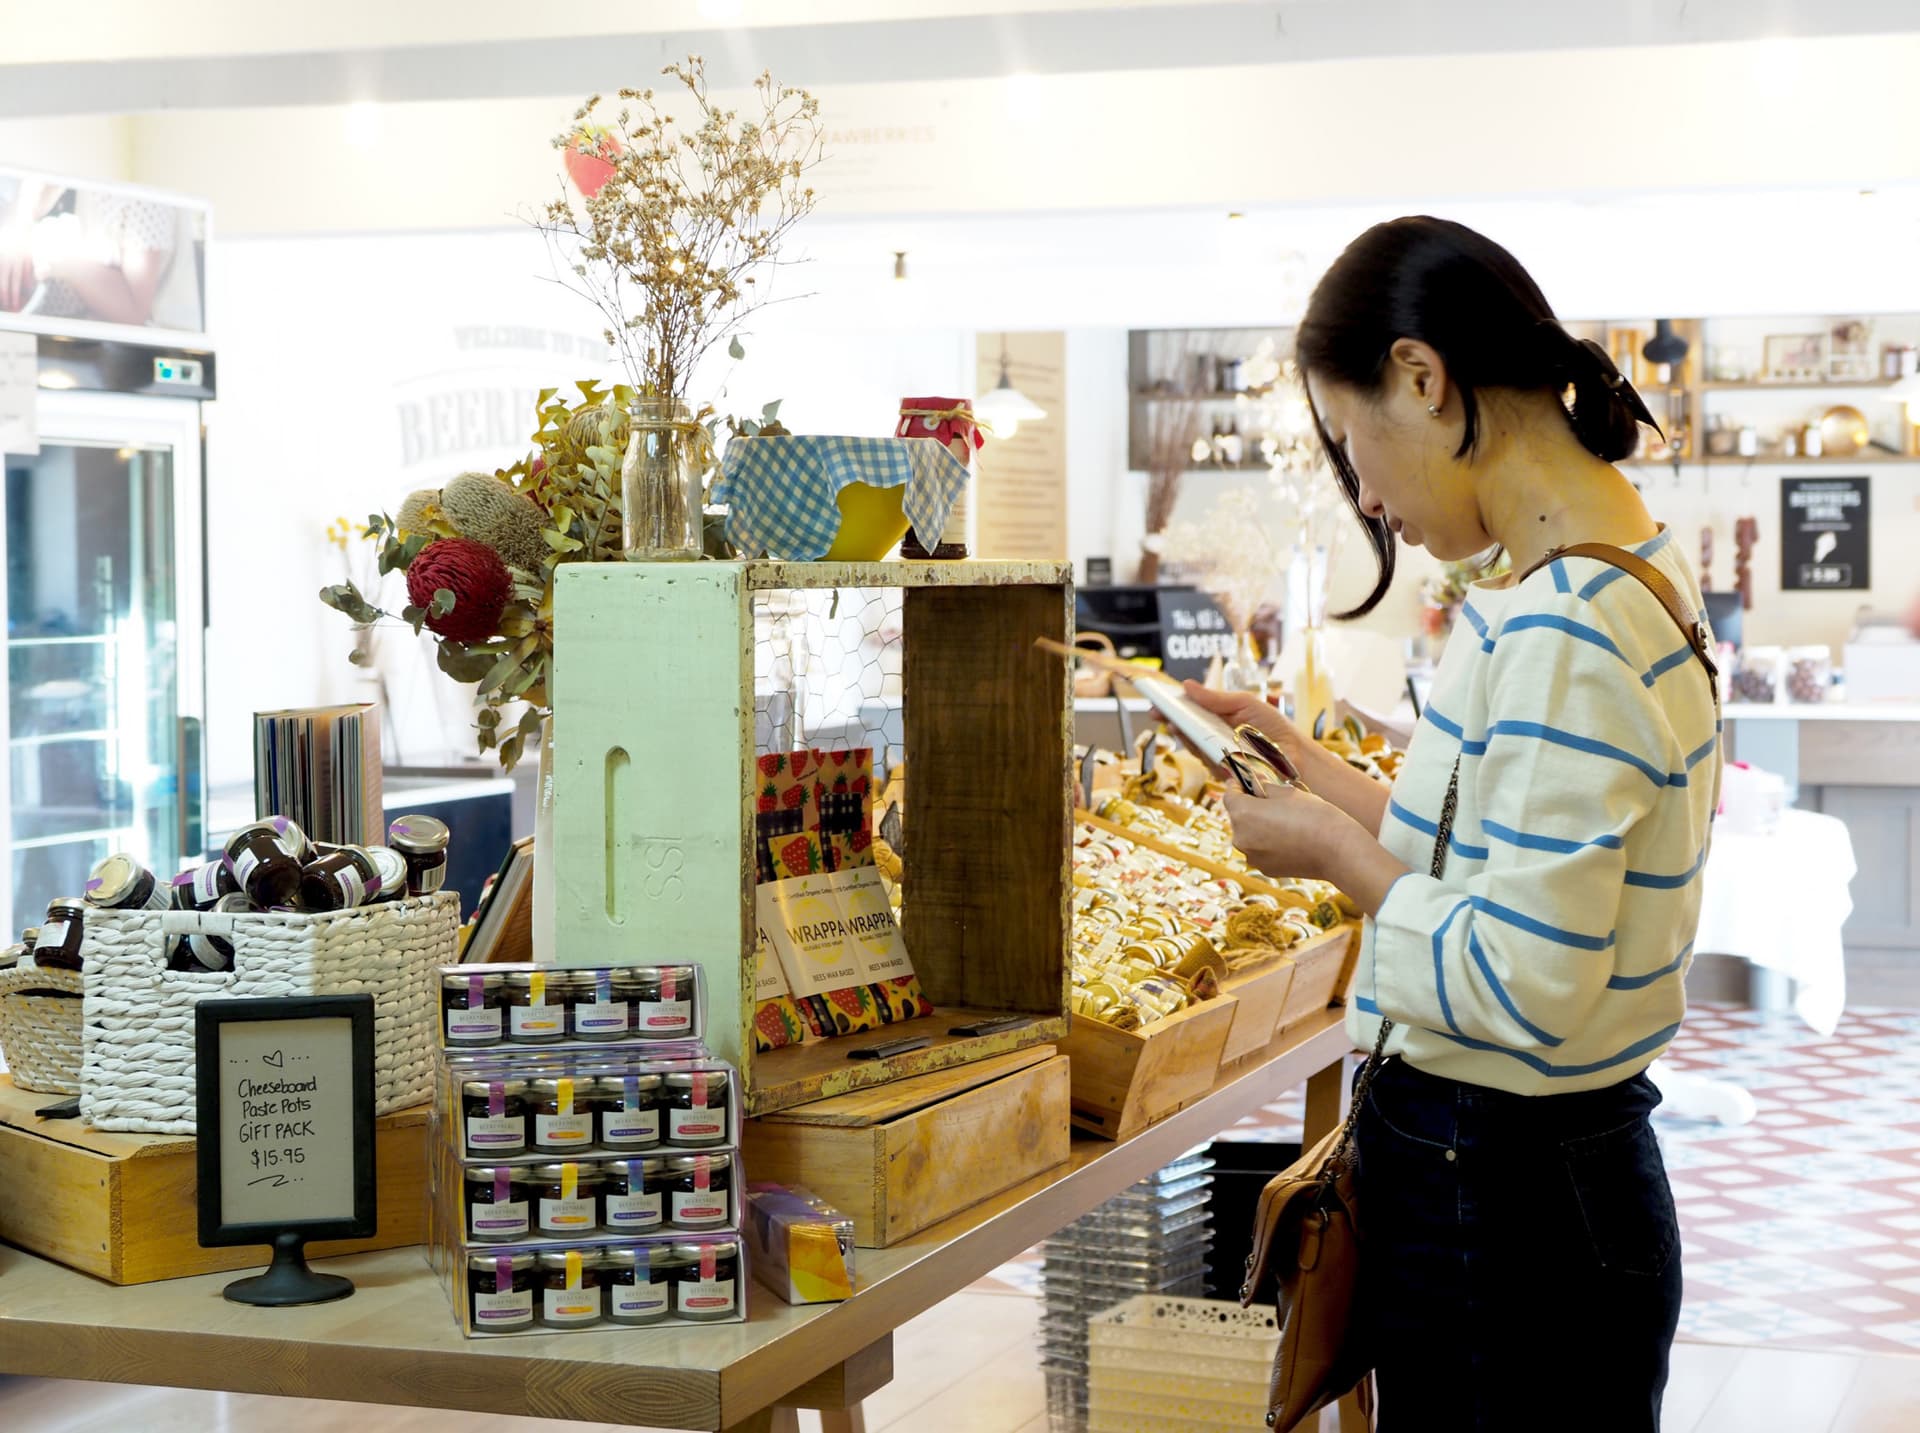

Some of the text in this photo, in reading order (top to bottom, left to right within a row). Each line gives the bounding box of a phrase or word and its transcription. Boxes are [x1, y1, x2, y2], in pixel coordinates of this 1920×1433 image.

[786, 919, 847, 945] WRAPPA
[847, 911, 896, 935] WRAPPA
[838, 968, 855, 979] BASED
[891, 958, 904, 968] BASED
[238, 1076, 317, 1098] Cheeseboard
[243, 1098, 312, 1119] Paste Pots
[275, 1120, 315, 1140] PACK
[251, 1148, 305, 1169] $15.95
